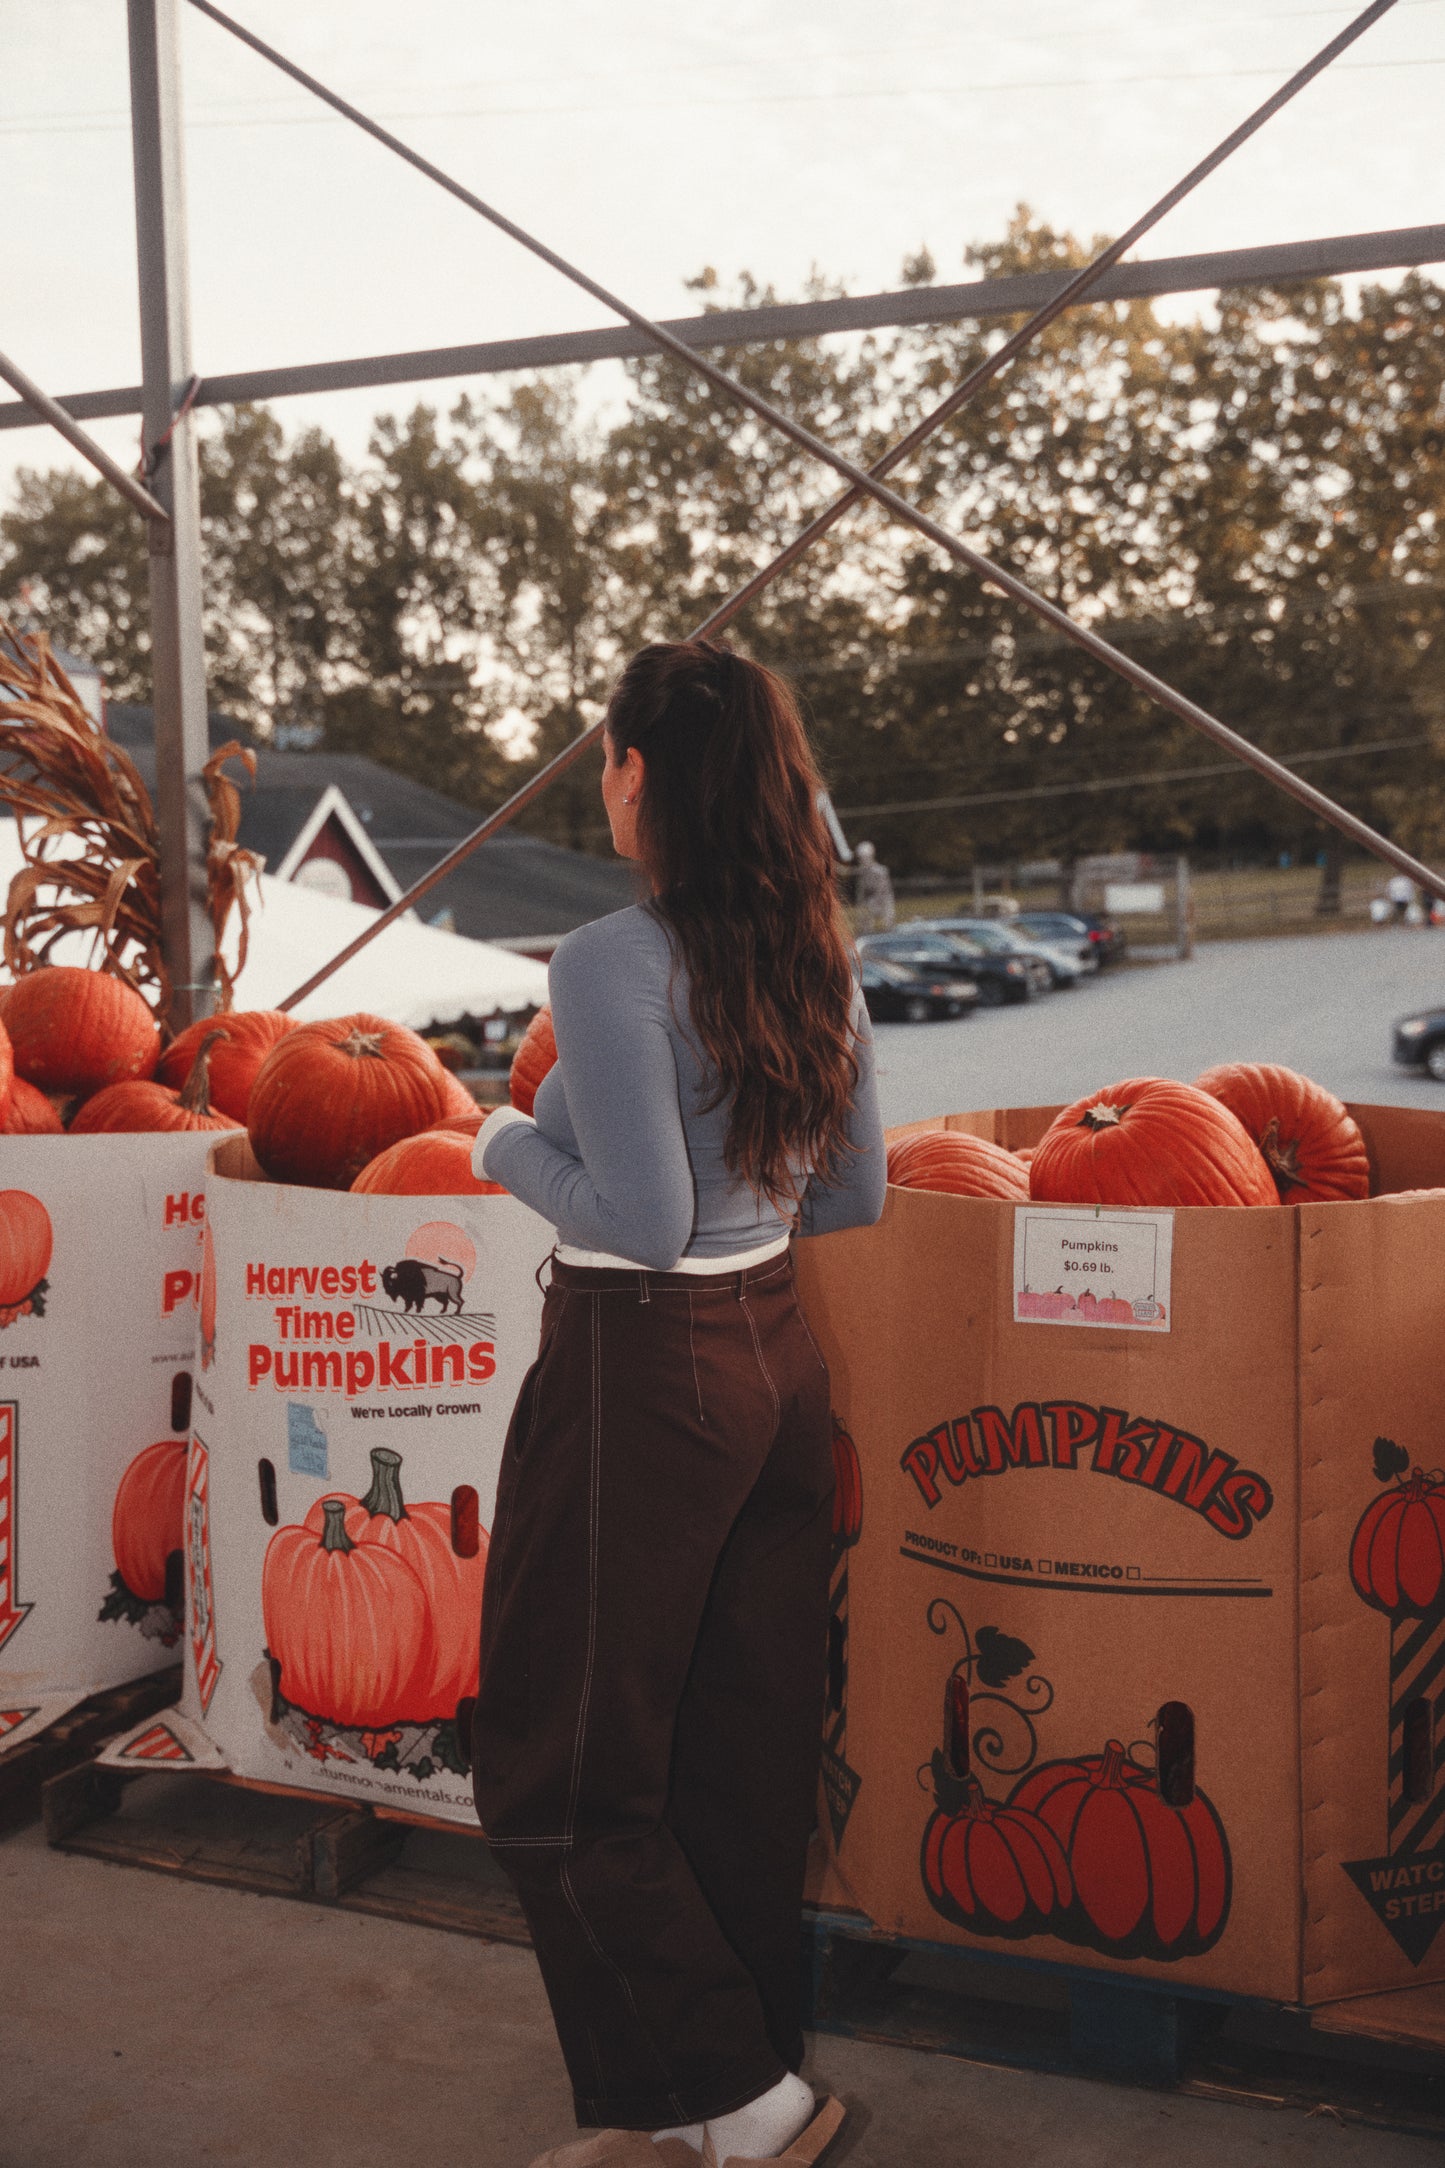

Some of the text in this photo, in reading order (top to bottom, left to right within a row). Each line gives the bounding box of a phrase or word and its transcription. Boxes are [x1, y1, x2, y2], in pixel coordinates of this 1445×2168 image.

[1061, 1239, 1118, 1253] Pumpkins
[245, 1259, 377, 1299] Harvest
[1064, 1260, 1114, 1274] $0.69 lb.
[274, 1305, 355, 1344] Time
[10, 1356, 40, 1368] USA
[247, 1339, 497, 1400] Pumpkins
[351, 1403, 481, 1419] We're Locally Grown
[901, 1400, 1274, 1540] PUMPKINS
[905, 1530, 1123, 1579] PRODUCT OF: USA MEXICO
[1369, 1861, 1445, 1893] WATC
